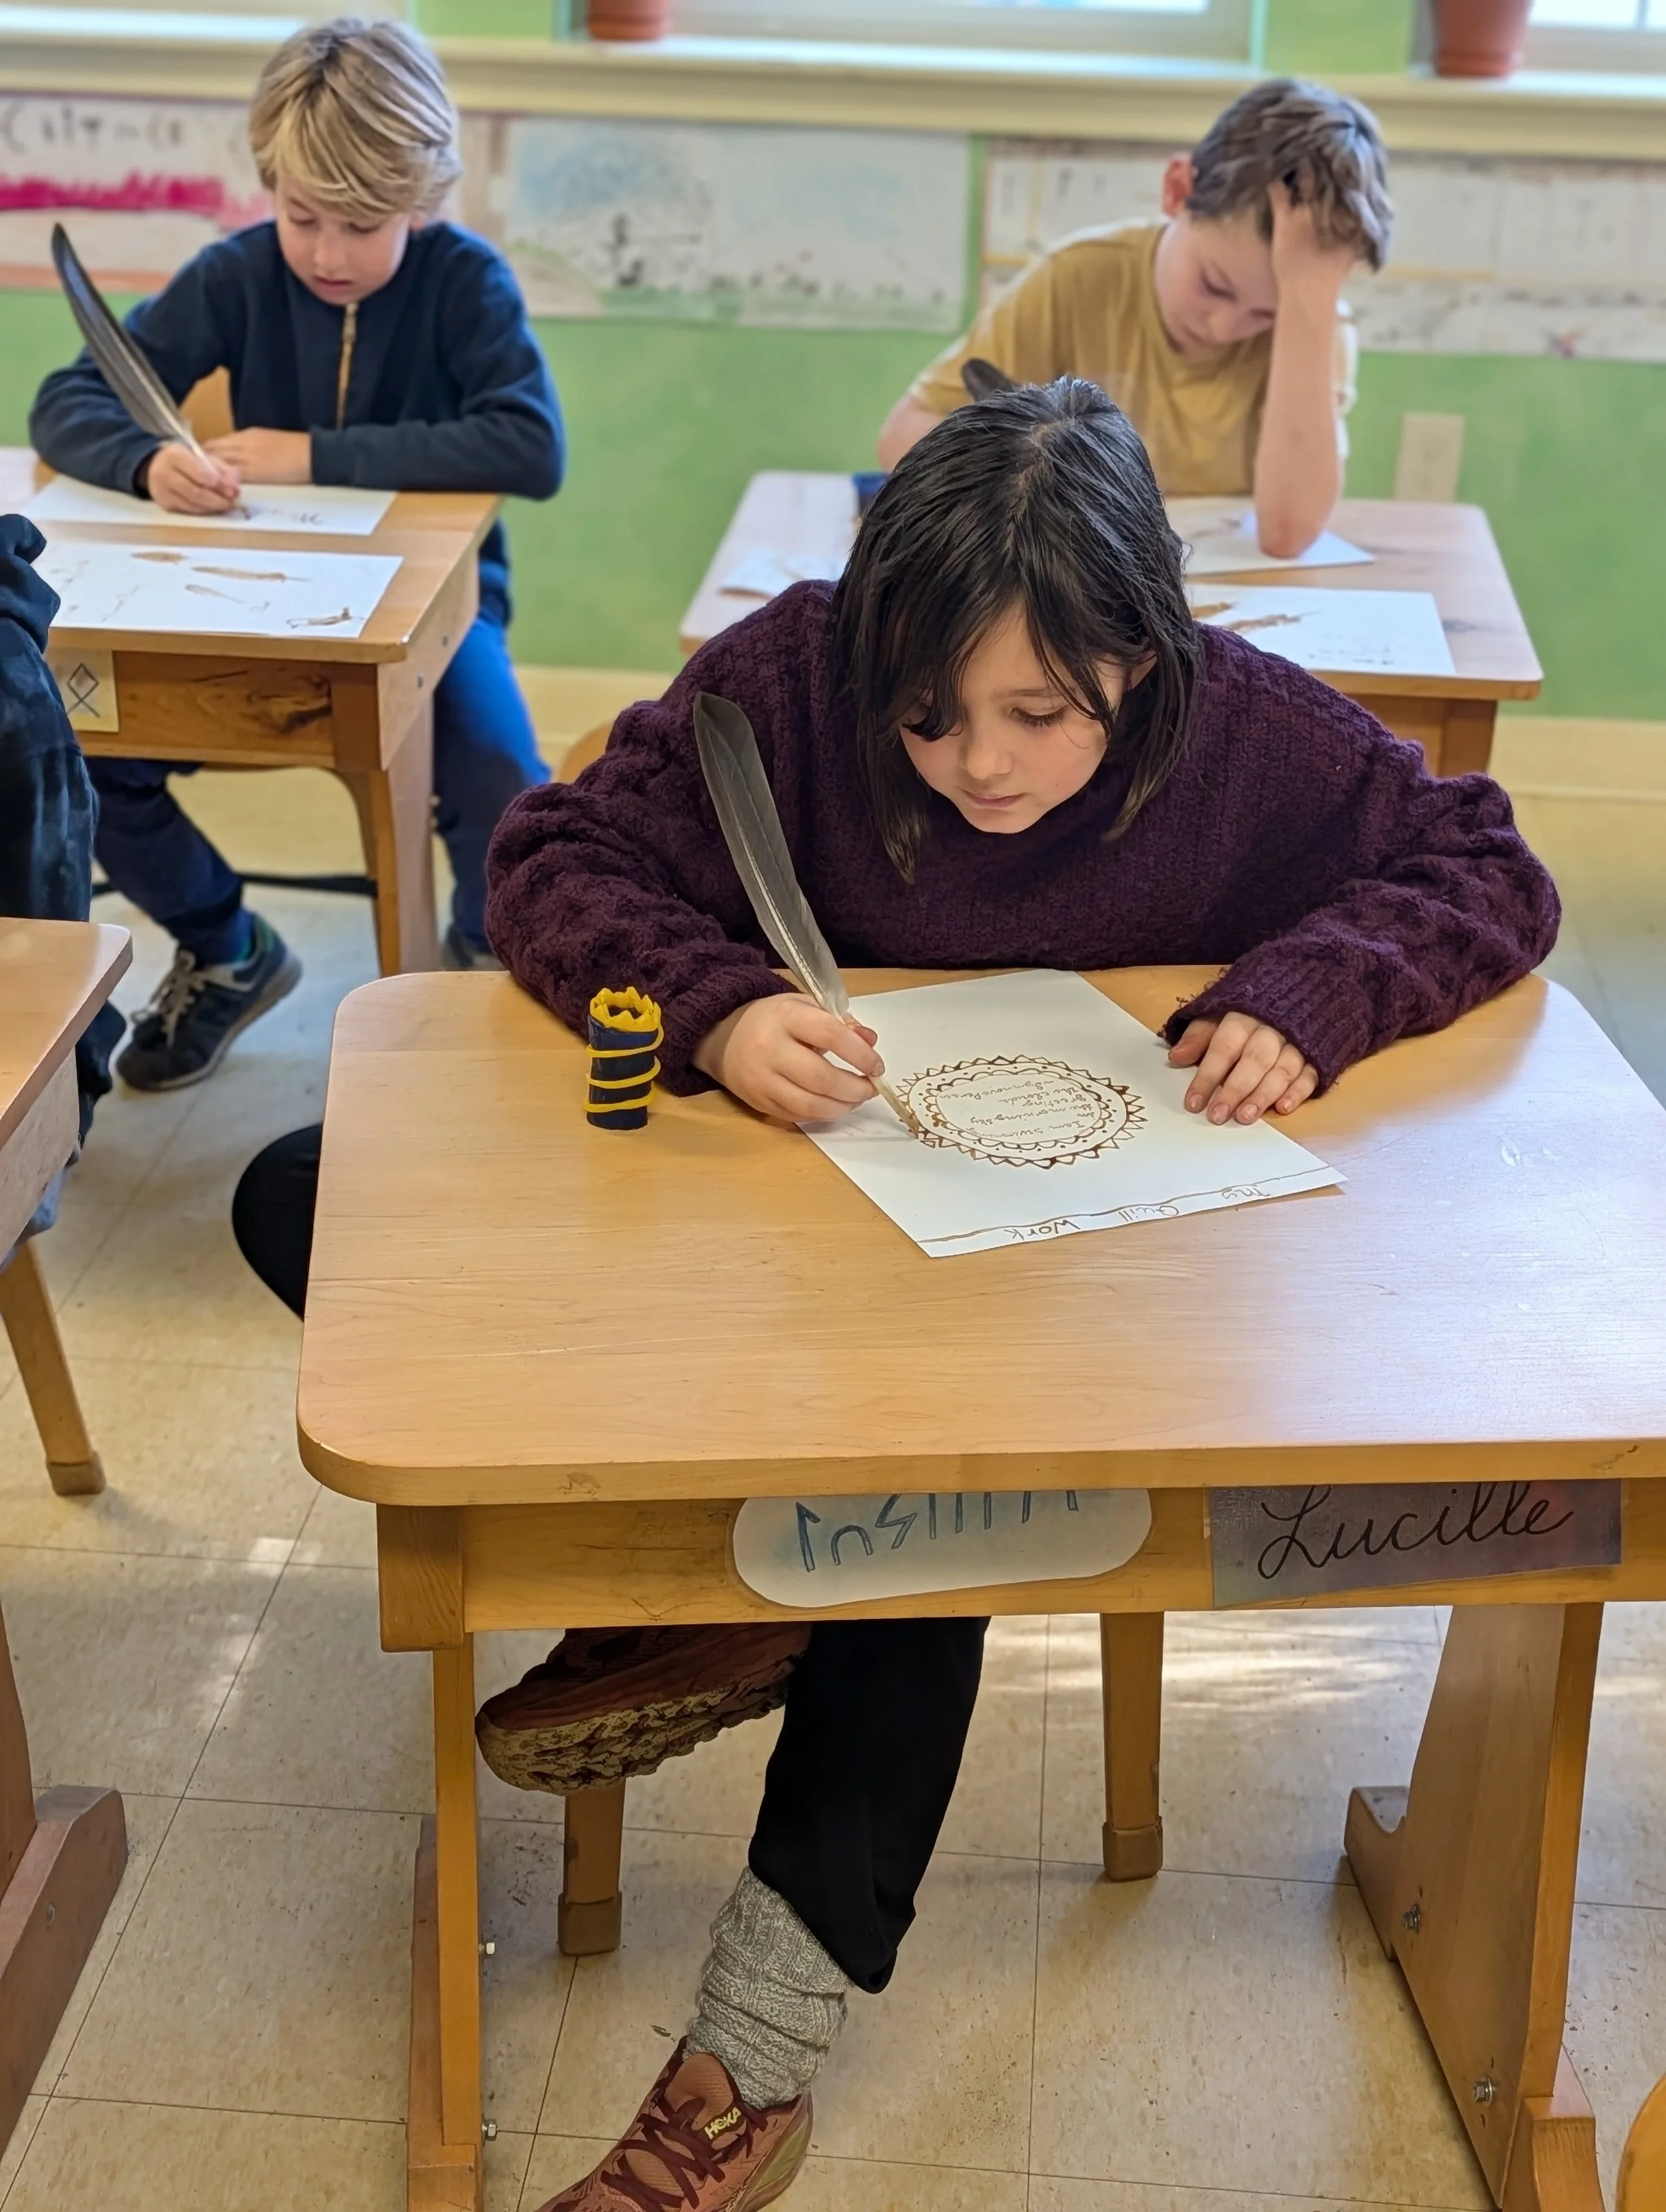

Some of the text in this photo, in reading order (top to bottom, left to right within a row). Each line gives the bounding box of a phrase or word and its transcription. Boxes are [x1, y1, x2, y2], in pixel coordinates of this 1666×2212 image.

[1118, 1205, 1179, 1222] Quill
[1257, 1480, 1574, 1580] Lucille
[704, 2107, 742, 2140] HOKA
